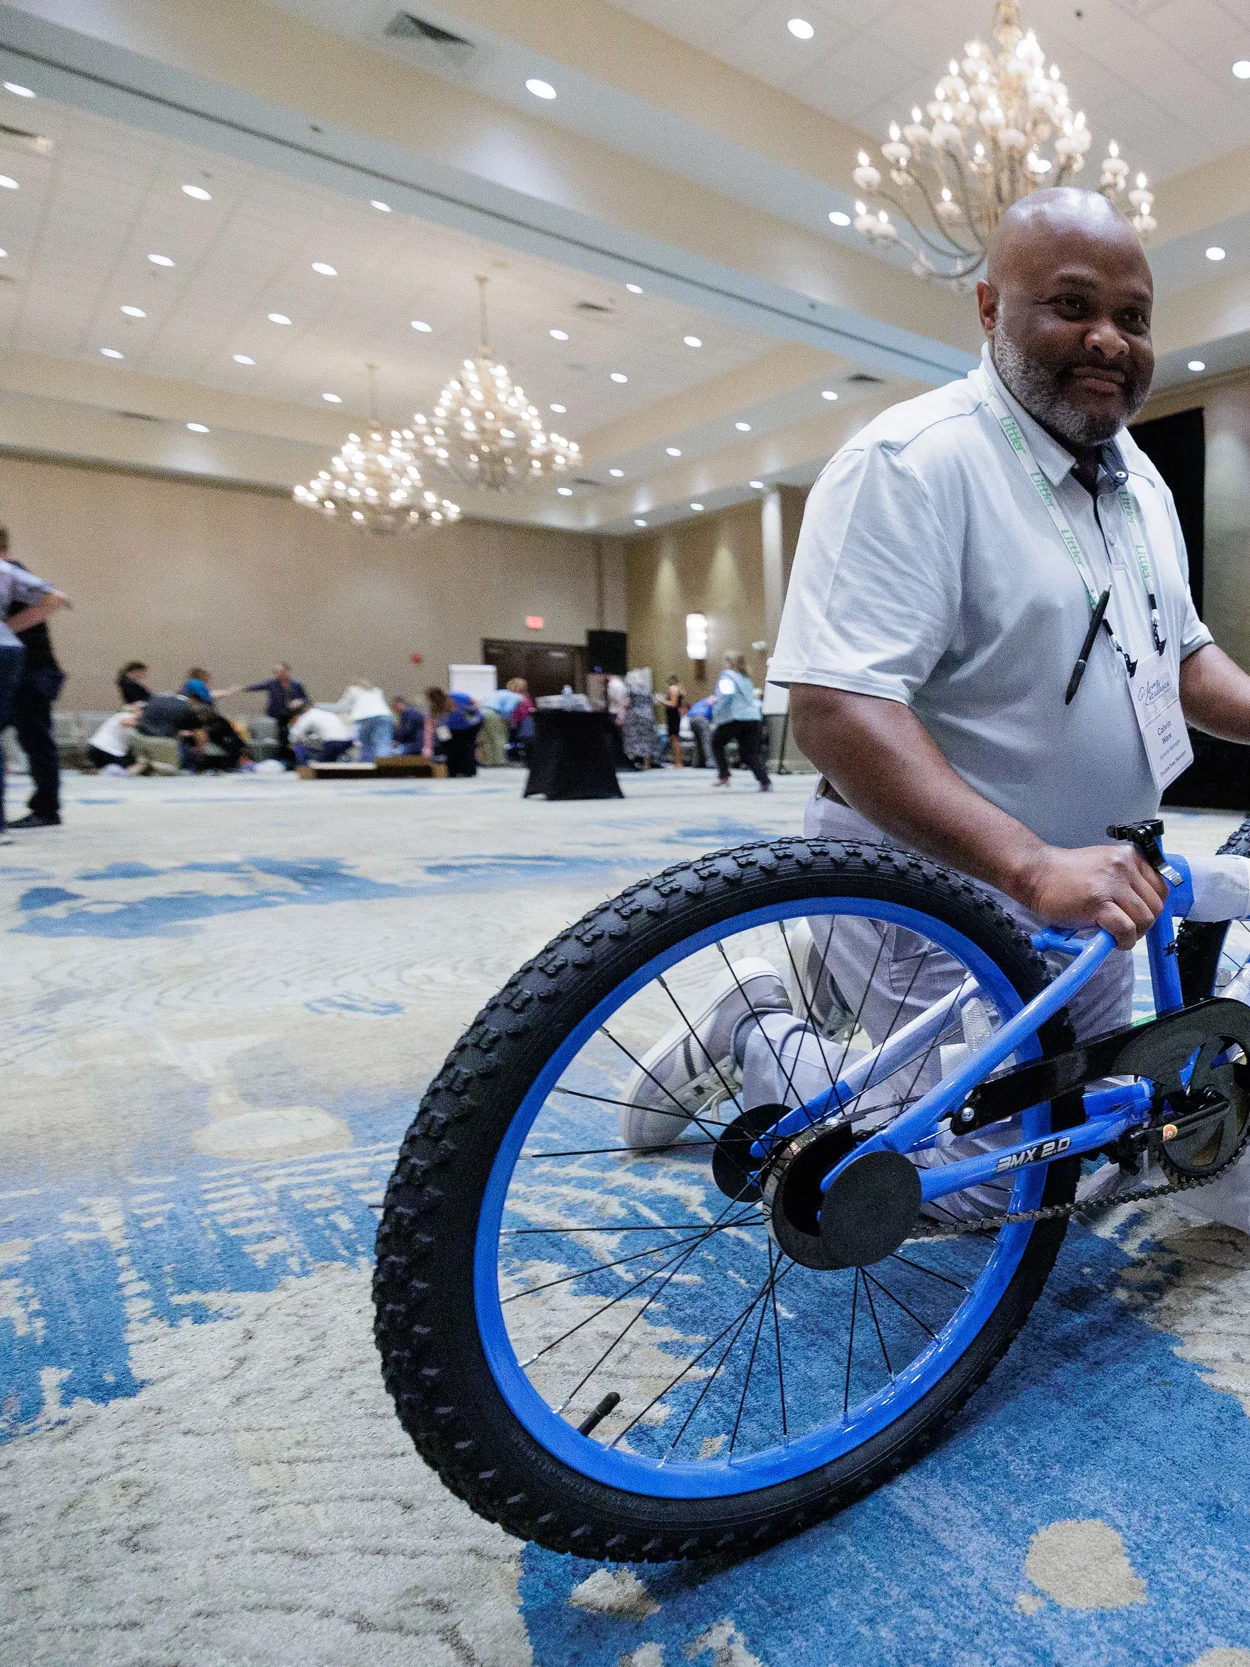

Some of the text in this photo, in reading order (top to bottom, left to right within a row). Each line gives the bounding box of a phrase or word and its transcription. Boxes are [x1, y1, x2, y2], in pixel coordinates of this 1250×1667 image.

[1000, 415, 1027, 454] Littler
[1030, 471, 1056, 510] Littler
[1061, 529, 1086, 568] Littler
[996, 1136, 1071, 1173] BMX 2.0
